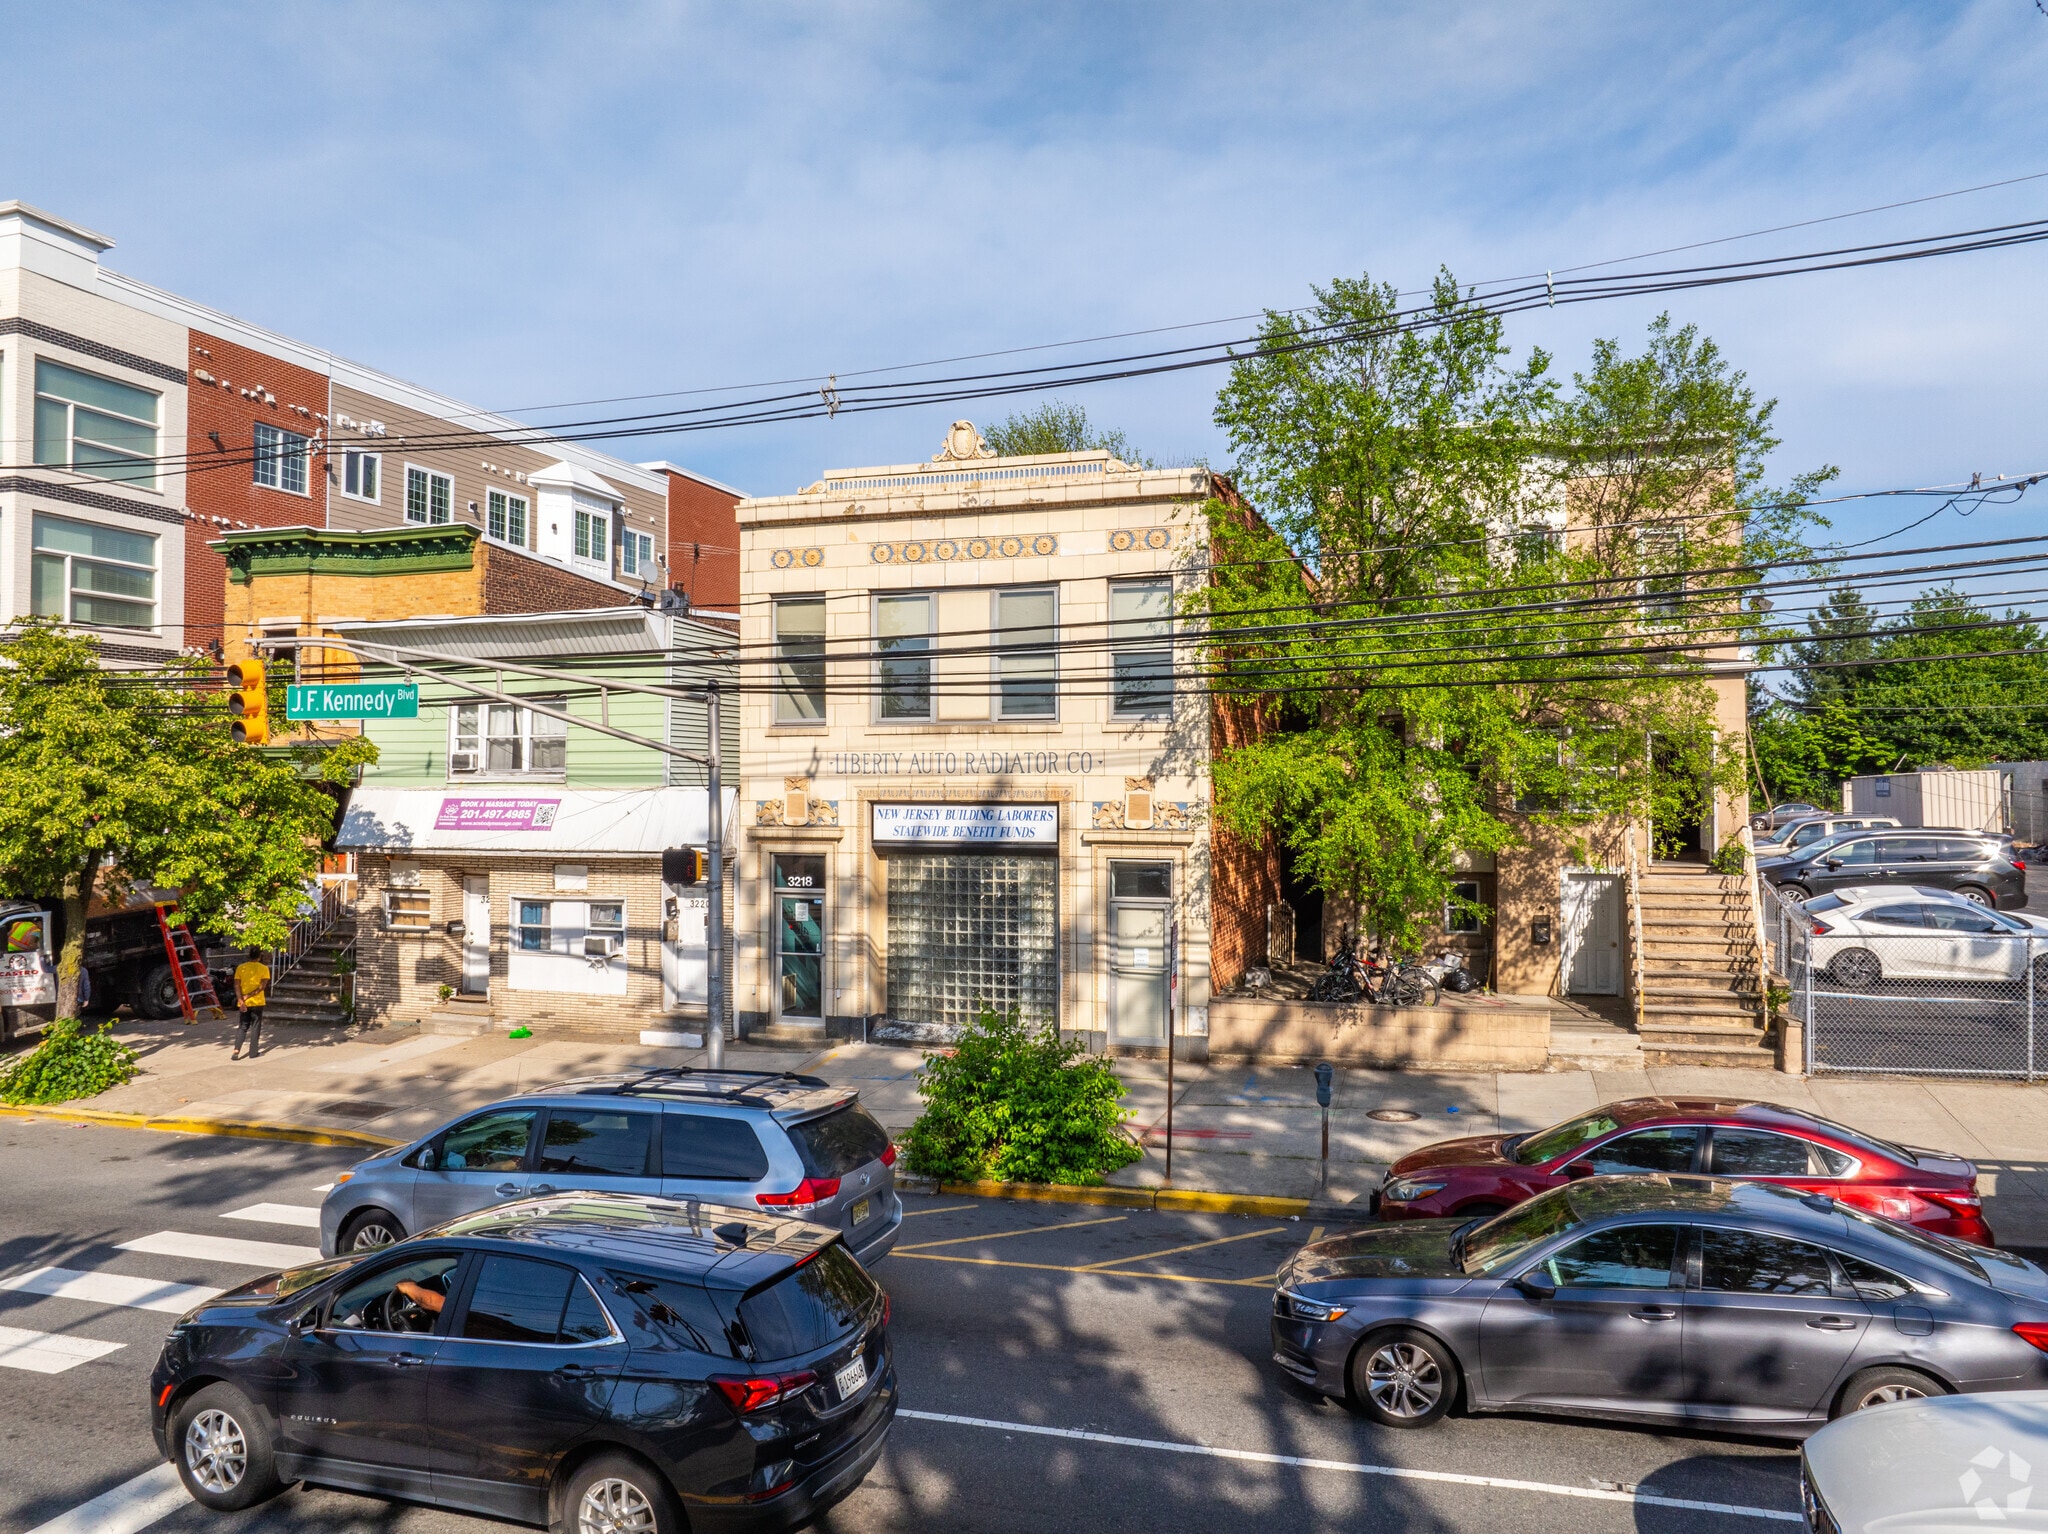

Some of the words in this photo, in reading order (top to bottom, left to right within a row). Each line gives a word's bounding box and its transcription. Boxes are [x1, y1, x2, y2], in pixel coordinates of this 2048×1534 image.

[323, 689, 395, 716] Kennedy
[397, 689, 414, 700] Blvd
[835, 753, 903, 775] LIBERTY
[908, 752, 956, 774] AUTO
[965, 751, 1059, 774] RADIATOR
[1067, 752, 1092, 774] CO
[460, 809, 532, 819] 201.497.4985
[877, 808, 900, 820] NEW
[903, 809, 942, 820] JERSEY
[945, 809, 994, 821] BUILDING
[997, 809, 1054, 822] LABORERS
[893, 825, 949, 837] STATEWIDE
[953, 826, 996, 838] BENEFIT
[1000, 826, 1035, 838] FUNDS
[787, 876, 812, 887] 3218
